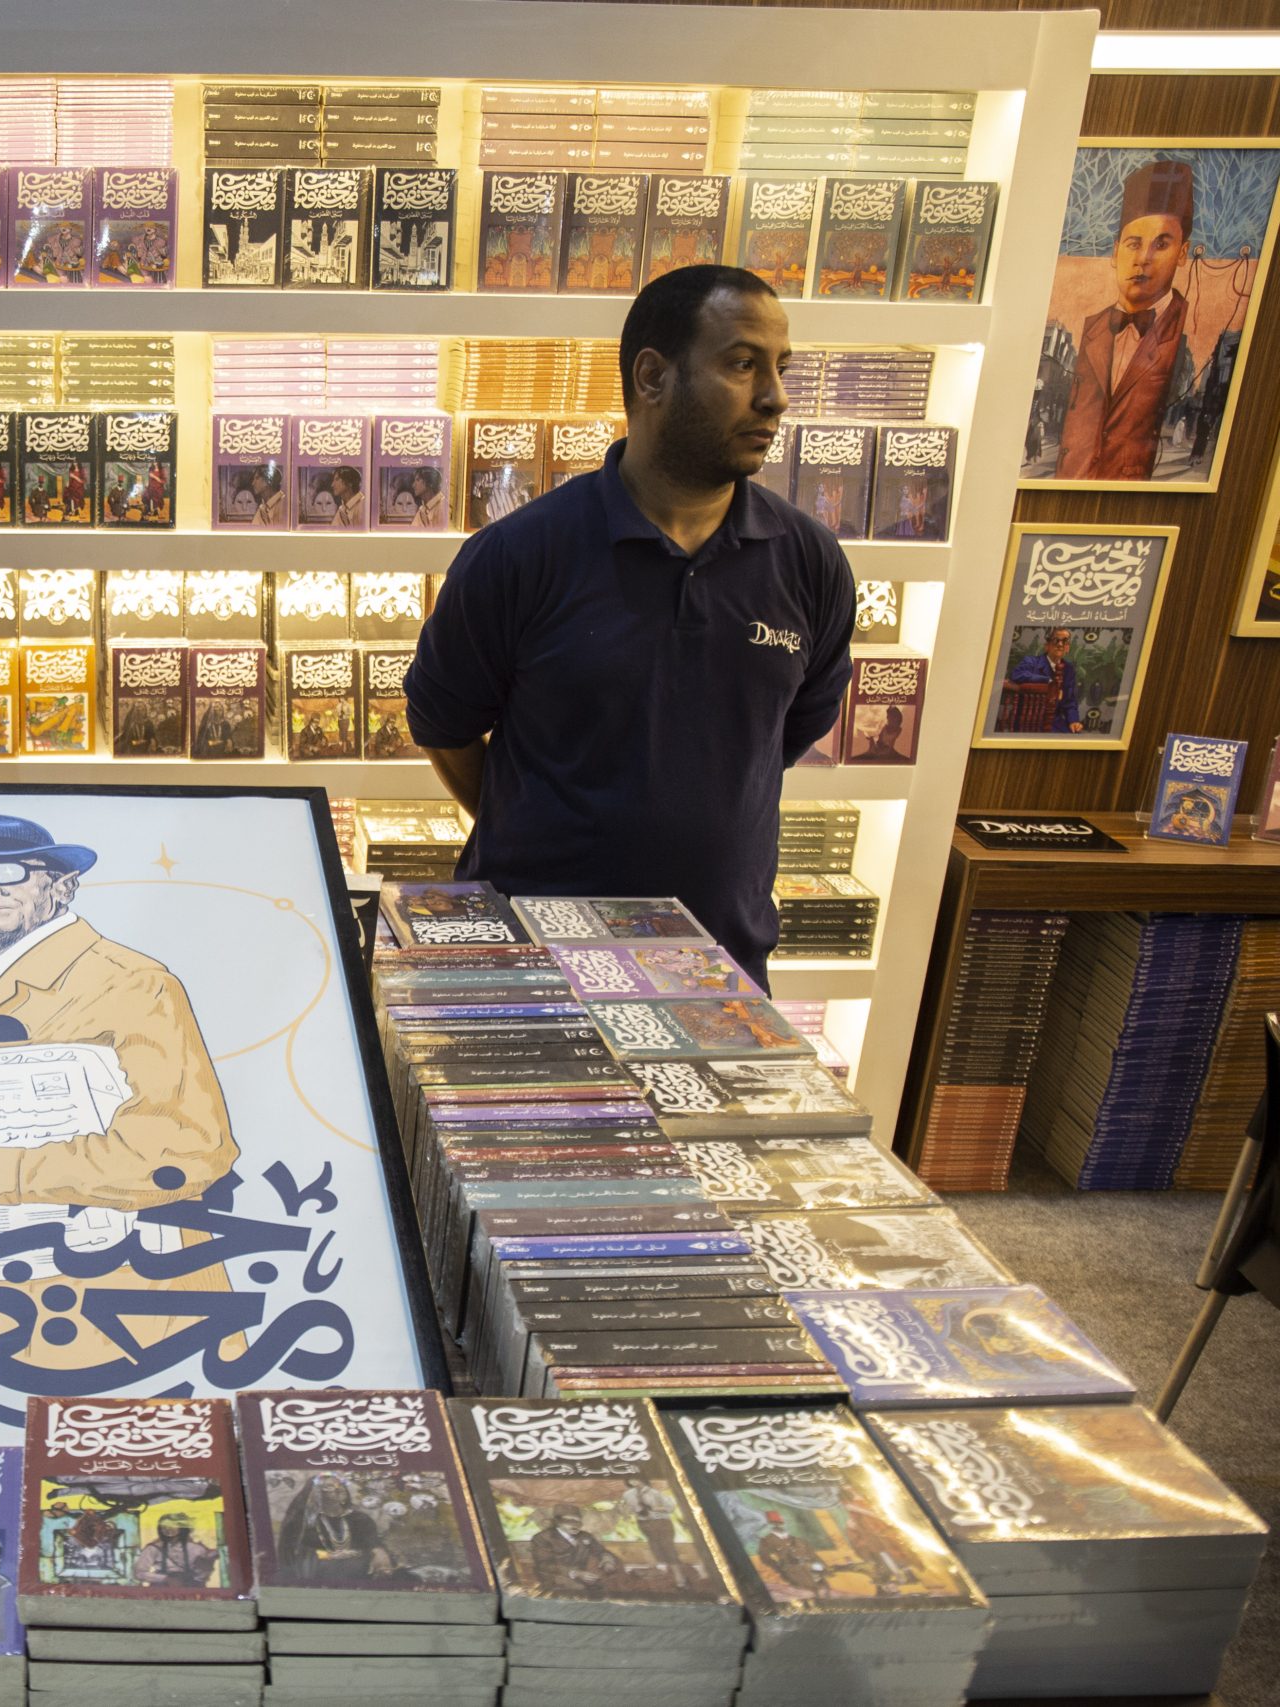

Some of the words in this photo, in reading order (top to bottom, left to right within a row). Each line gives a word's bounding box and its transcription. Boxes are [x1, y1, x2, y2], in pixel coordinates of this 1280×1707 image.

[1023, 539, 1140, 606] محفوظ
[1041, 540, 1142, 573] نجيب
[45, 1403, 212, 1457] محفوظ
[63, 1403, 204, 1430] نجيب
[259, 1397, 430, 1452] محفوظ
[276, 1397, 418, 1424] نجيب
[490, 1405, 631, 1432] نجيب
[471, 1405, 647, 1461] محفوظ
